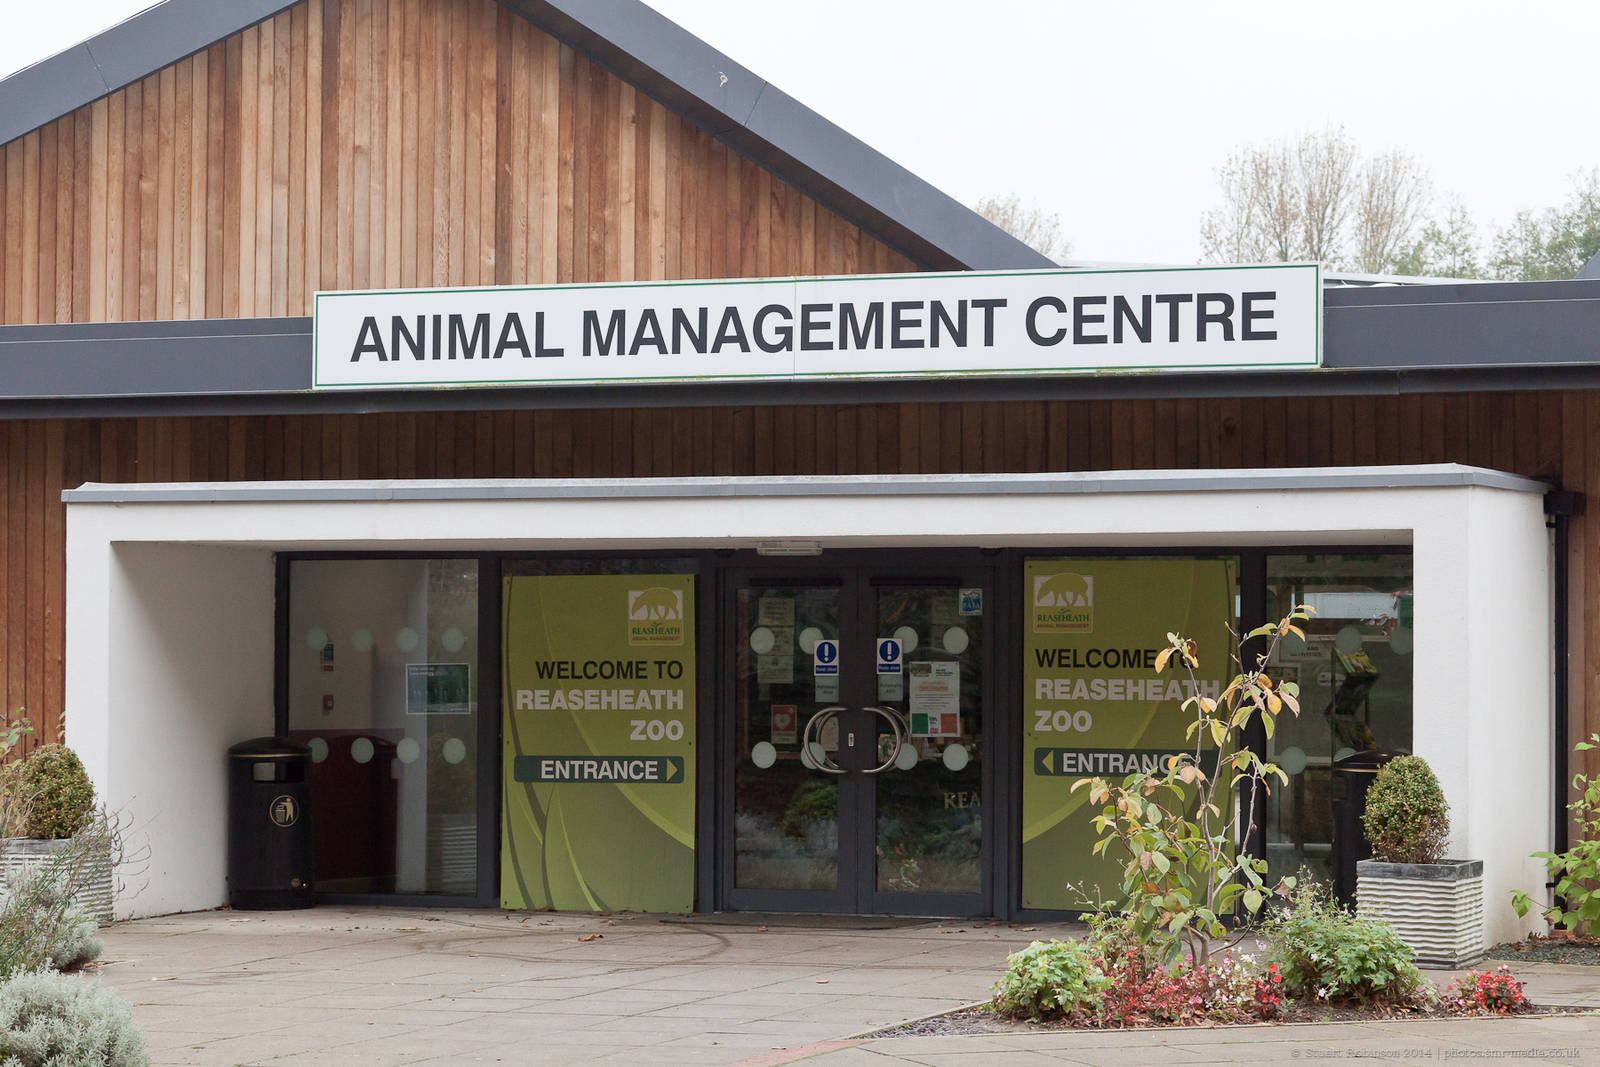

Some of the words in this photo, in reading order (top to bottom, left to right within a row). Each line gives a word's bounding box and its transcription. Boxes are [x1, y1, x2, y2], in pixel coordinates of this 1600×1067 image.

[350, 311, 565, 363] ANIMAL
[582, 298, 1007, 356] MANAGEMENT
[1025, 291, 1278, 347] CENTRE
[1037, 614, 1090, 622] REASEHEATH
[632, 626, 681, 635] REASEHEATH
[1035, 648, 1157, 669] WELCOME
[536, 660, 648, 680] WELCOME
[653, 660, 684, 680] TO
[516, 689, 684, 711] REASEHEATH
[1035, 678, 1220, 701] REASEHEATH
[630, 719, 685, 742] ZOO
[1034, 710, 1093, 732] ZOO
[541, 760, 658, 780] ENTRANCE
